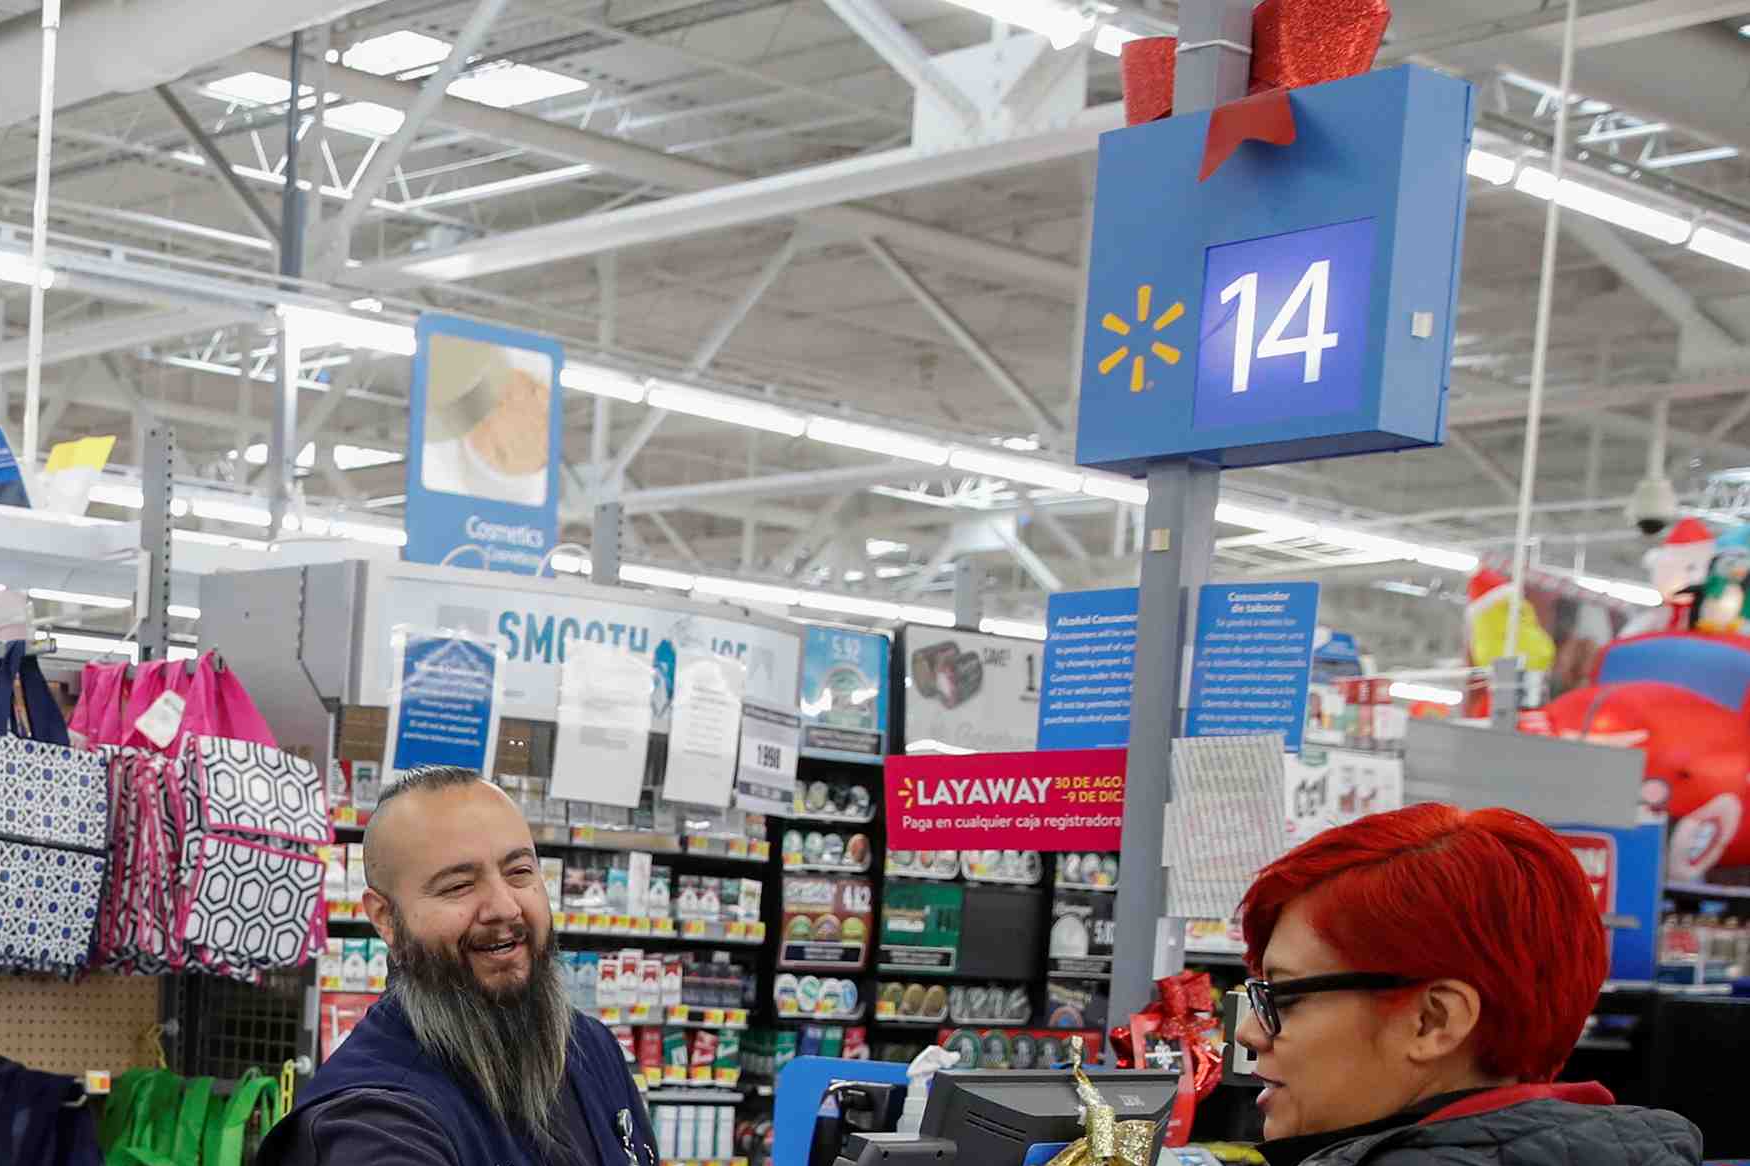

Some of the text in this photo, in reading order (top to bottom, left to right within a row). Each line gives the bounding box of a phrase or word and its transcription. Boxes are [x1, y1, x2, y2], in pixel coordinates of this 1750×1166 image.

[1219, 260, 1338, 393] 14
[465, 515, 545, 548] Cosmetics
[917, 777, 1052, 806] LAYAWAY
[1055, 777, 1071, 789] 30
[1073, 777, 1090, 789] DE
[1079, 791, 1097, 803] DE
[902, 813, 1122, 832] Paga en cualquier caja registradora
